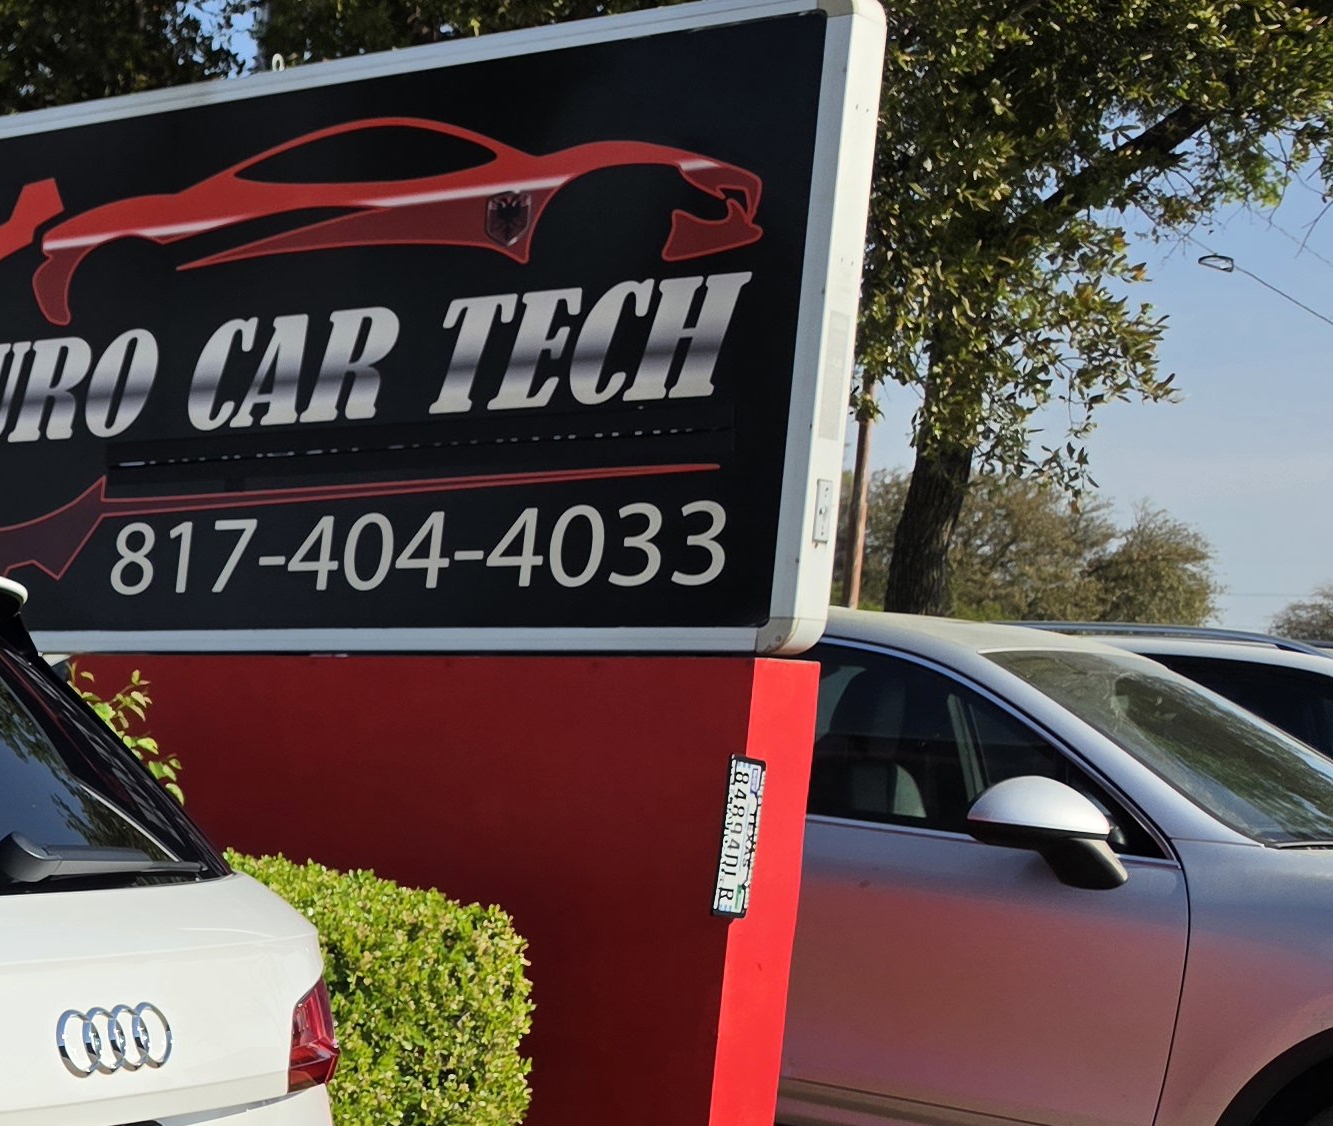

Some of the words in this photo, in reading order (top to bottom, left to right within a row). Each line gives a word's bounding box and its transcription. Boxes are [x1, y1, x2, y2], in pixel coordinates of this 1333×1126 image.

[186, 306, 401, 431] CAR
[430, 271, 753, 415] TECH
[109, 499, 728, 597] 817-404-4033
